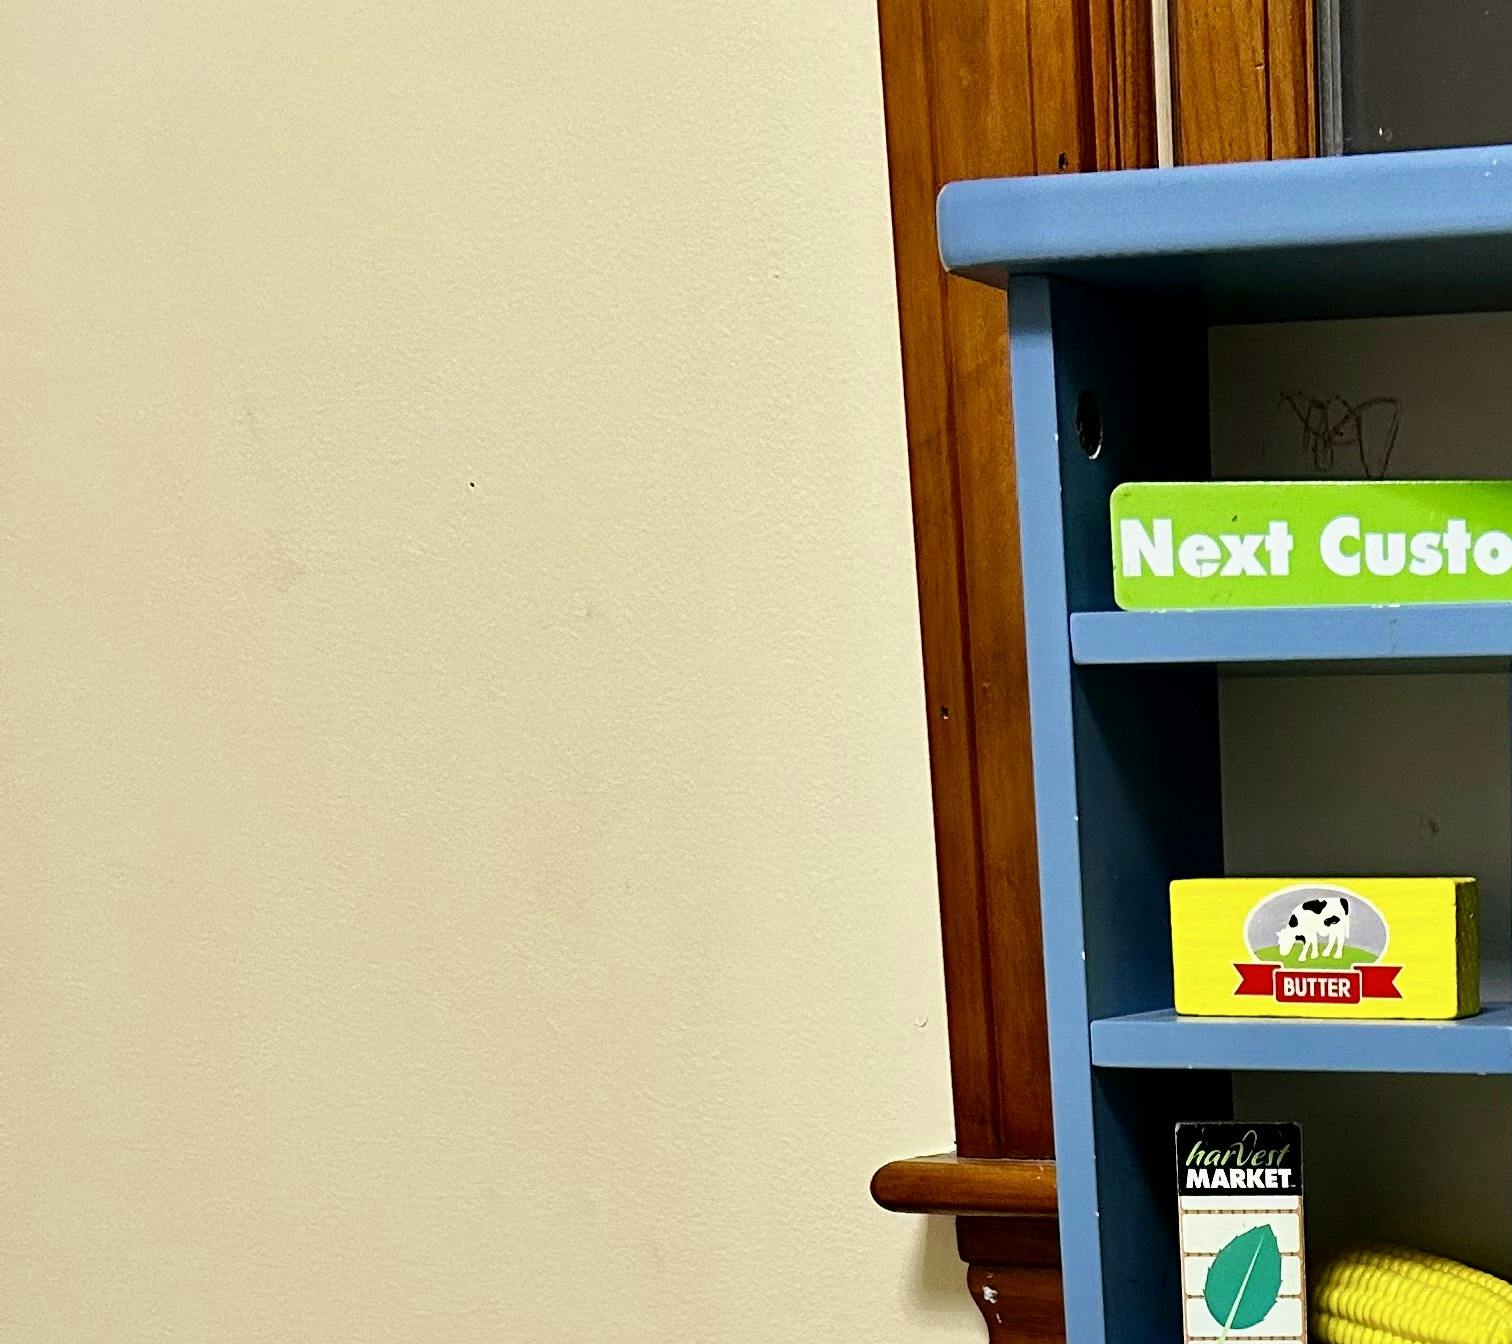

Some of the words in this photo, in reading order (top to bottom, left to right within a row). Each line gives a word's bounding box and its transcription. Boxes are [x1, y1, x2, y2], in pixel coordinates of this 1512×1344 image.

[1120, 519, 1293, 577] Next
[1283, 977, 1350, 998] BUTTER
[1186, 1130, 1290, 1166] harvest
[1186, 1168, 1292, 1188] MARKET
